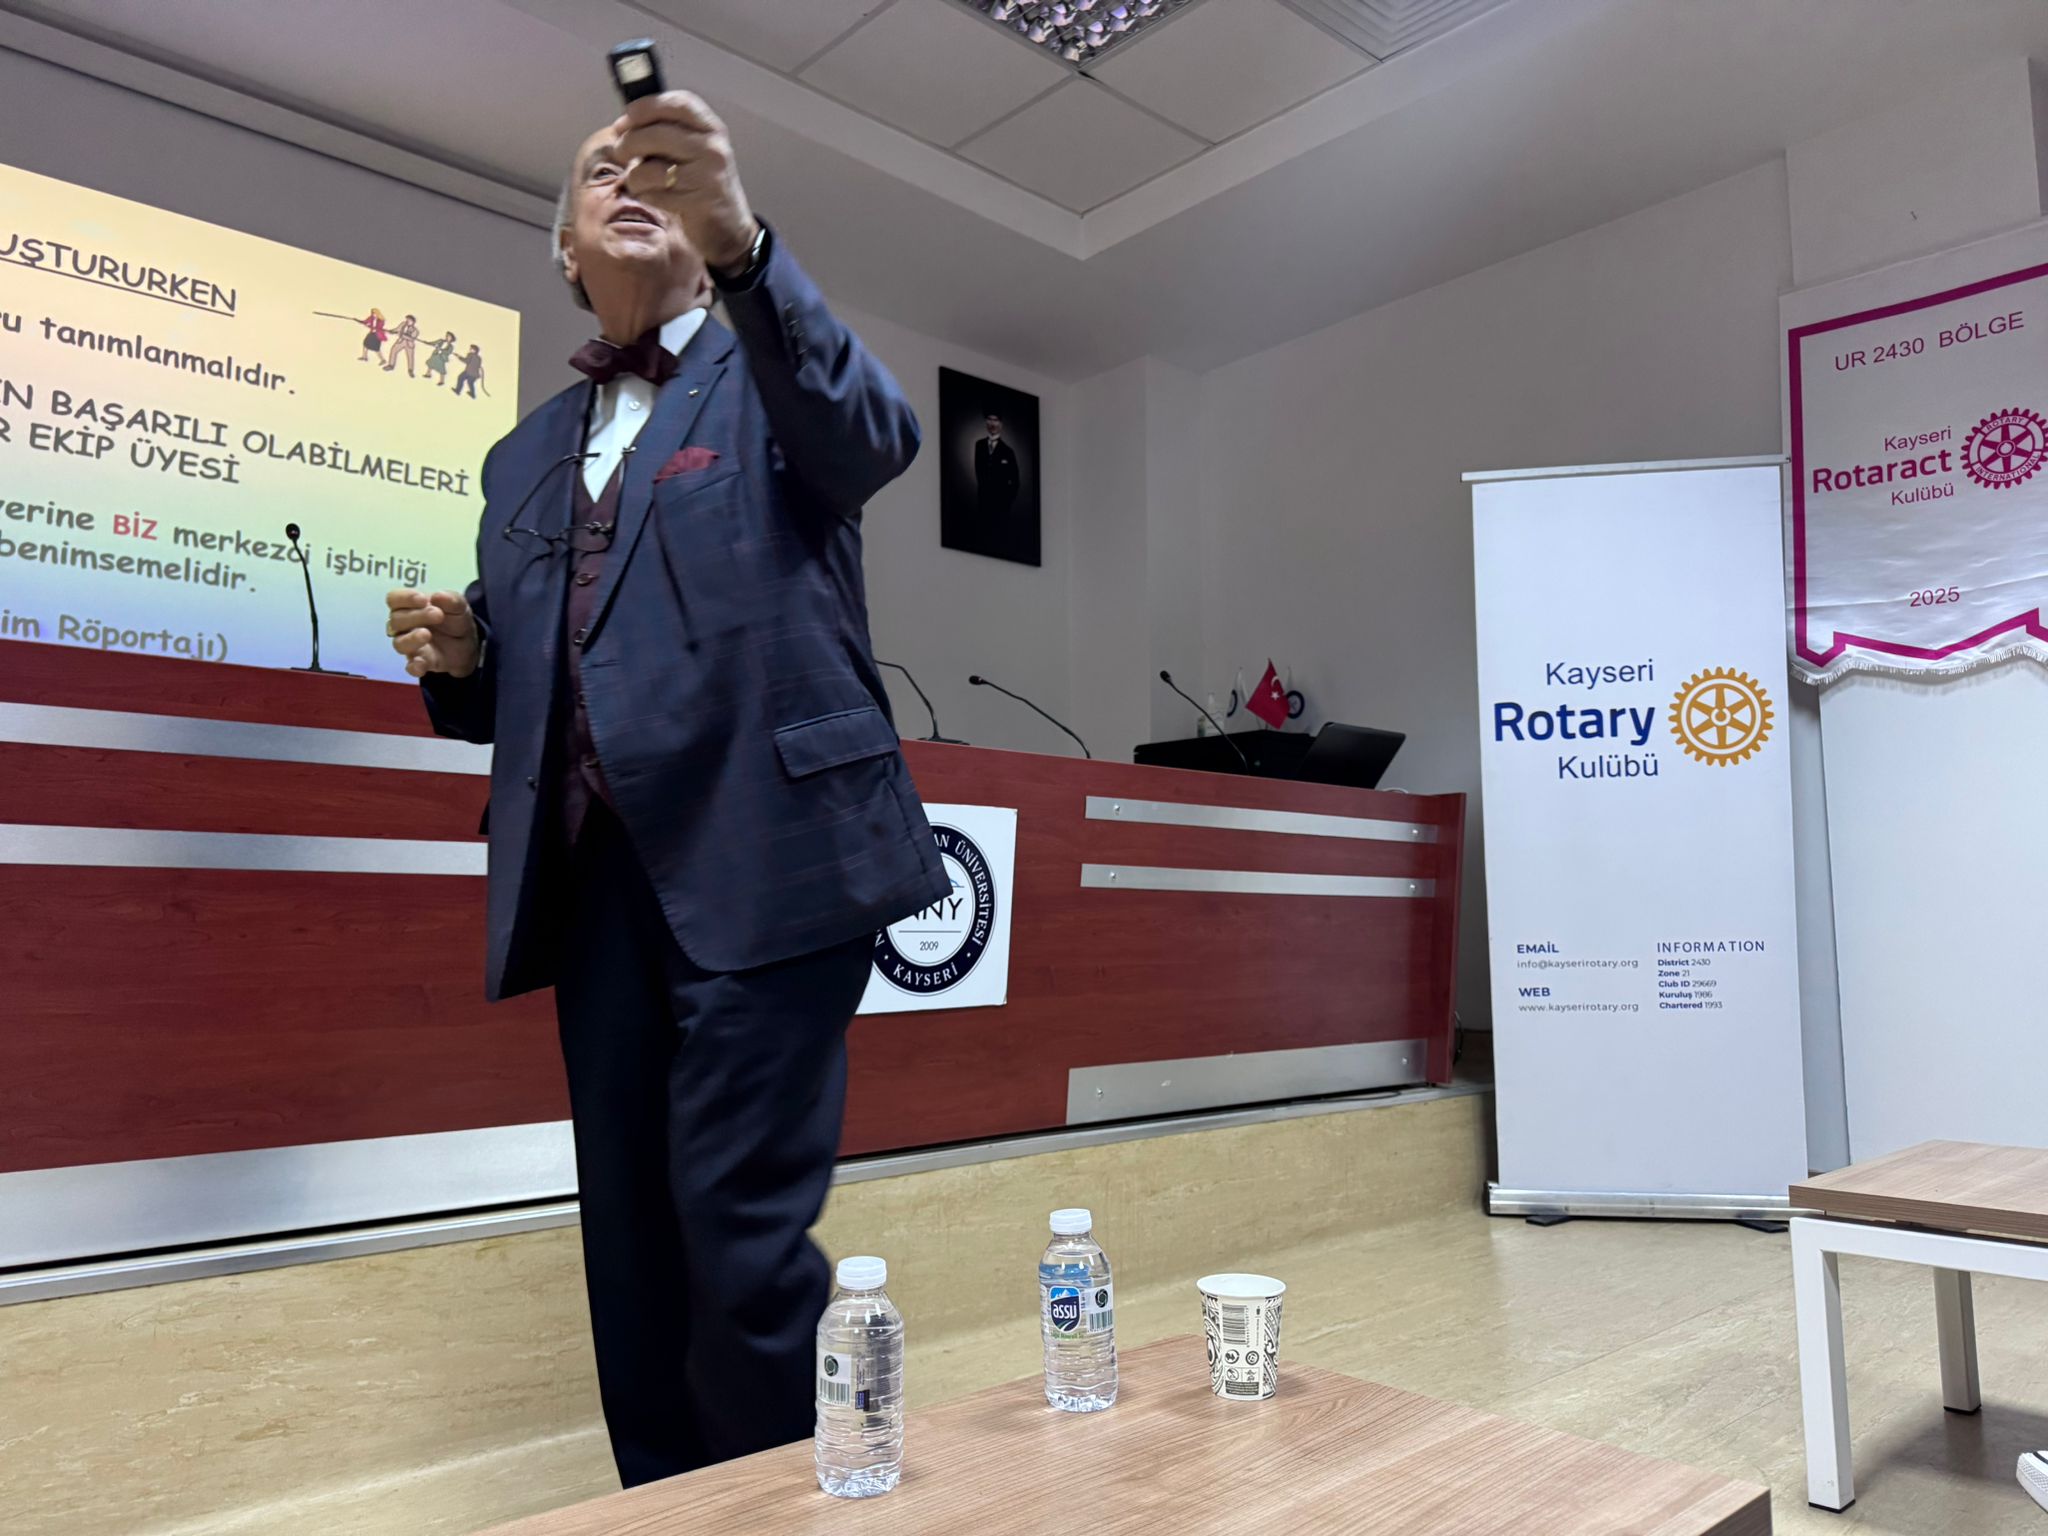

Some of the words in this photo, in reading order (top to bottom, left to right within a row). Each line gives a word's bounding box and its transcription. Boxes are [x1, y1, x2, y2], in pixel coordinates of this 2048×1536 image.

[0, 312, 22, 333] u
[1835, 351, 1866, 371] UR
[1873, 337, 1925, 364] 2430
[1939, 311, 2024, 349] BÖLGE
[1986, 416, 2024, 431] ROTARY
[0, 379, 34, 411] N
[51, 390, 228, 448] BAŞARILI
[243, 430, 469, 496] OLABİLMELERİ
[1884, 425, 1952, 451] Kayseri
[29, 422, 115, 460] EKİP
[130, 437, 240, 484] ÜYESİ
[1813, 449, 1952, 493] Rotaract
[1976, 454, 2040, 481] INTERNATIONAL
[1891, 482, 1954, 506] Kulübü
[0, 499, 95, 531] erine
[113, 511, 158, 541] BİZ
[326, 547, 428, 588] işbirliği
[1909, 586, 1960, 607] 2025
[58, 614, 228, 662] Röportajı)
[1545, 659, 1655, 690] Kayseri
[1494, 702, 1656, 746] Rotary
[1558, 753, 1659, 779] Kulübü
[955, 838, 992, 947] ÜNİVERSİTESİ
[919, 940, 939, 951] 2009
[1516, 941, 1560, 954] EMAİL
[1656, 940, 1765, 953] INFORMATION
[893, 960, 959, 987] KAYSERİ
[1516, 958, 1639, 970] info@kayserirotary.org
[1657, 958, 1689, 967] District
[1657, 969, 1680, 978] Zone
[1518, 986, 1551, 998] WEB
[1658, 980, 1679, 988] Club
[1680, 980, 1690, 988] ID
[1658, 990, 1692, 1000] Kuruluş
[1518, 1002, 1639, 1013] www.kayserirotary.org
[1659, 1001, 1703, 1010] Chartered
